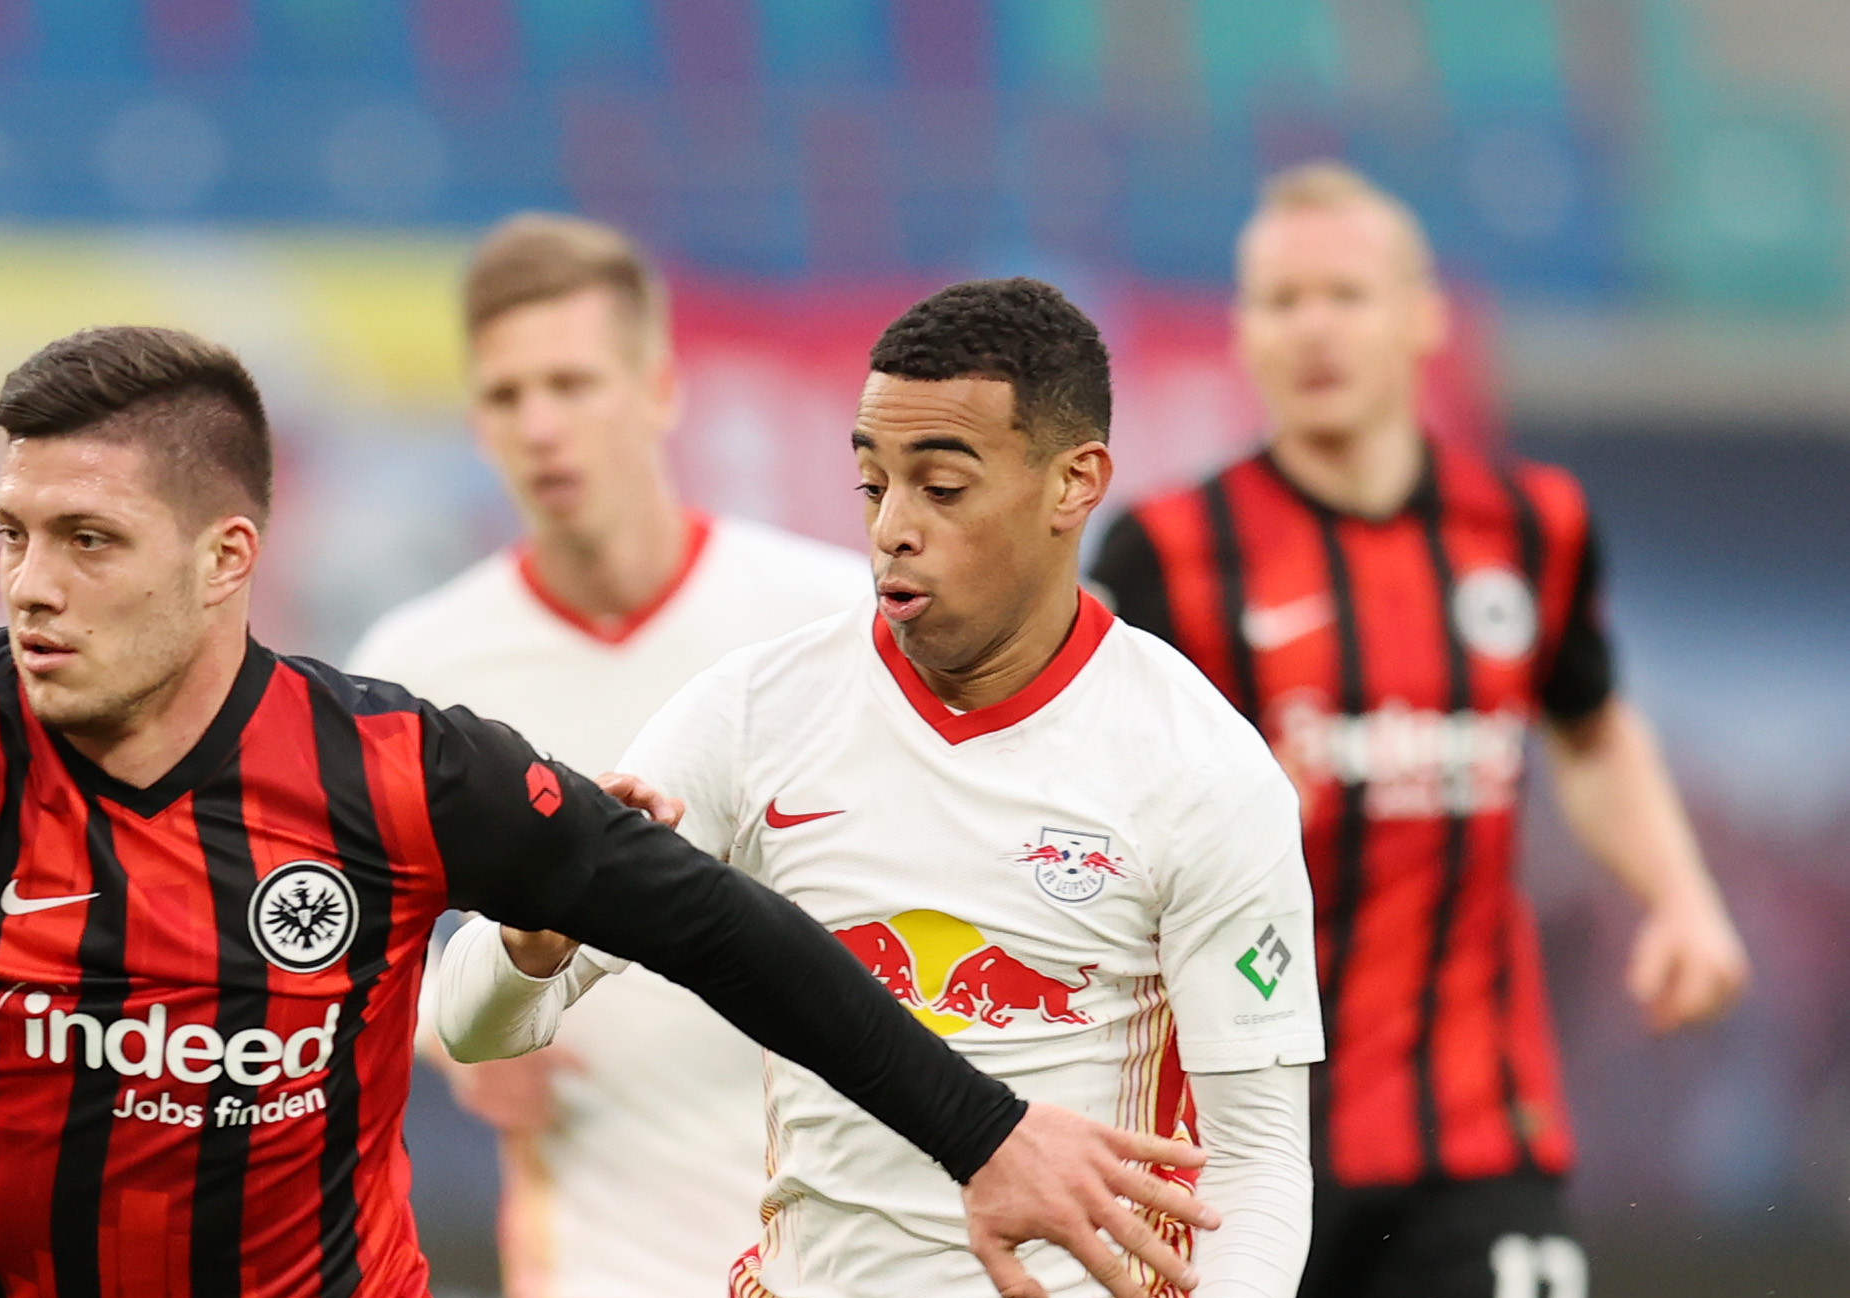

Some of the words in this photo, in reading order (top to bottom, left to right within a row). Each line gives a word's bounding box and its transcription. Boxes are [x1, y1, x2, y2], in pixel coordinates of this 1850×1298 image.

[24, 991, 341, 1086] indeed
[112, 1089, 204, 1128] Jobs
[213, 1087, 327, 1128] finden
